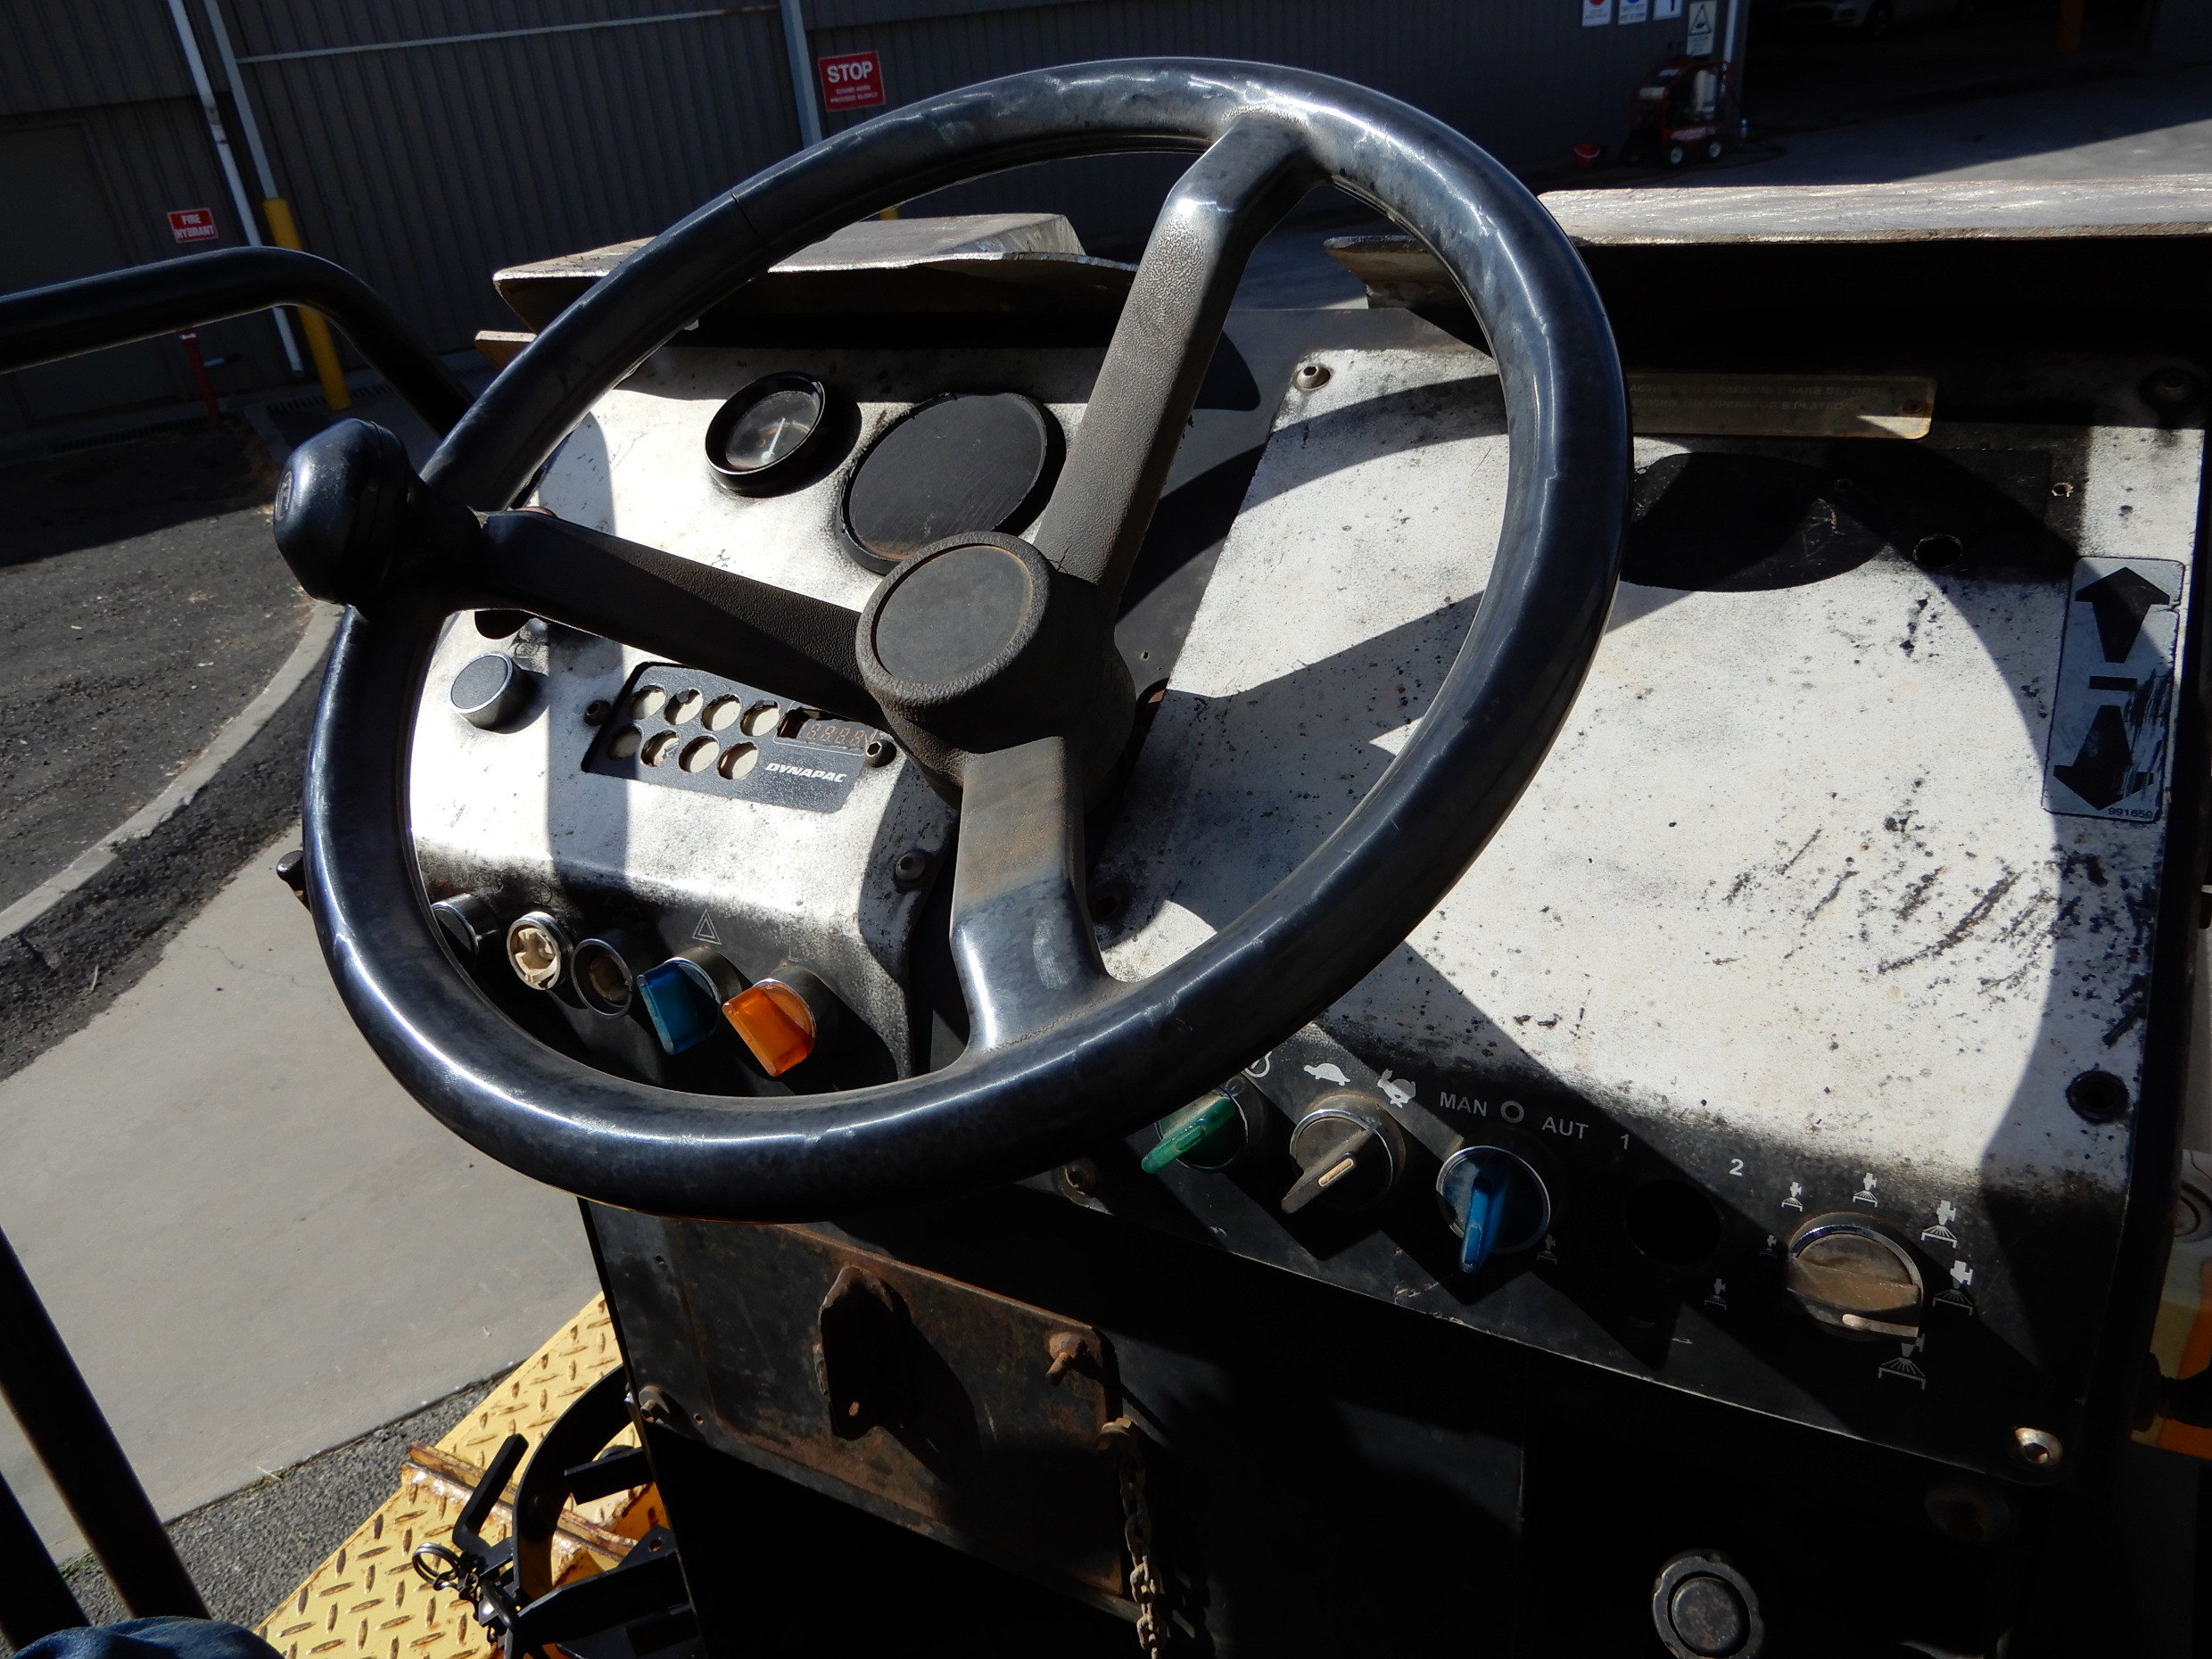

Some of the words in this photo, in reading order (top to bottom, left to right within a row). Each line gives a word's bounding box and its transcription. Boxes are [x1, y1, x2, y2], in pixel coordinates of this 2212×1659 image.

[827, 61, 873, 83] STOP
[181, 214, 202, 225] FIRE
[174, 225, 214, 239] HYDRANT
[1631, 399, 1678, 408] EAVING
[764, 763, 847, 783] DYNAPAC
[1440, 1092, 1488, 1118] MAN
[1541, 1116, 1589, 1140] AUT
[1620, 1134, 1630, 1150] 1
[1729, 1158, 1744, 1176] 2
